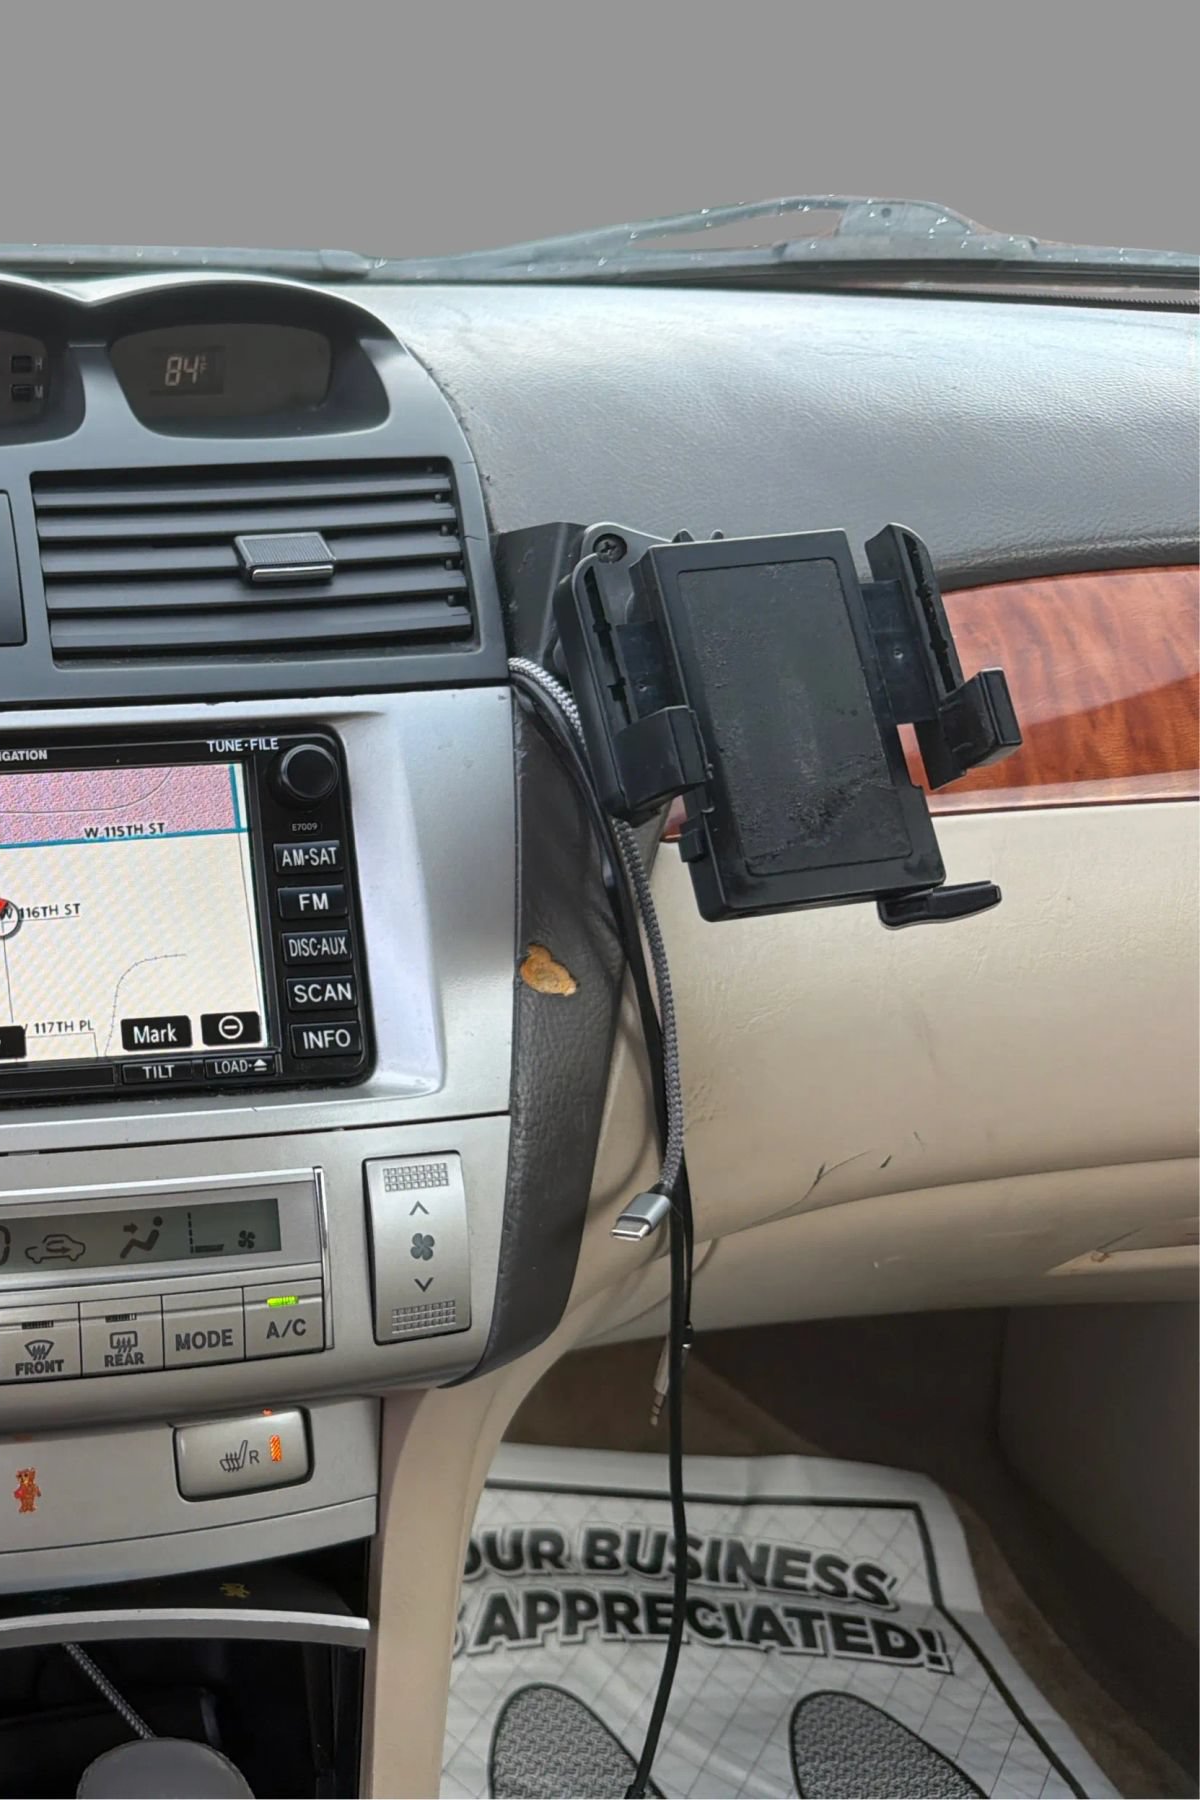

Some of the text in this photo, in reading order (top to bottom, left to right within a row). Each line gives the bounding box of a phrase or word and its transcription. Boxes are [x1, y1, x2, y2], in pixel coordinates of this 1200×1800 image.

[164, 354, 200, 386] 84
[83, 822, 166, 839] W 115TH ST
[19, 904, 59, 918] 116TH
[64, 903, 81, 915] ST
[298, 893, 330, 912] FM
[293, 983, 353, 1004] SCAN
[34, 1021, 74, 1035] 117TH
[79, 1020, 95, 1032] PL
[133, 1023, 178, 1044] Mark
[302, 1029, 351, 1050] INFO
[141, 1064, 175, 1081] TILT
[266, 1318, 308, 1340] A/C
[175, 1329, 234, 1352] MODE
[14, 1359, 64, 1375] FRONT
[104, 1352, 145, 1368] REAR
[248, 1447, 261, 1465] R
[584, 1527, 890, 1606] BUSINESS
[472, 1587, 948, 1668] APPRECIATED!
